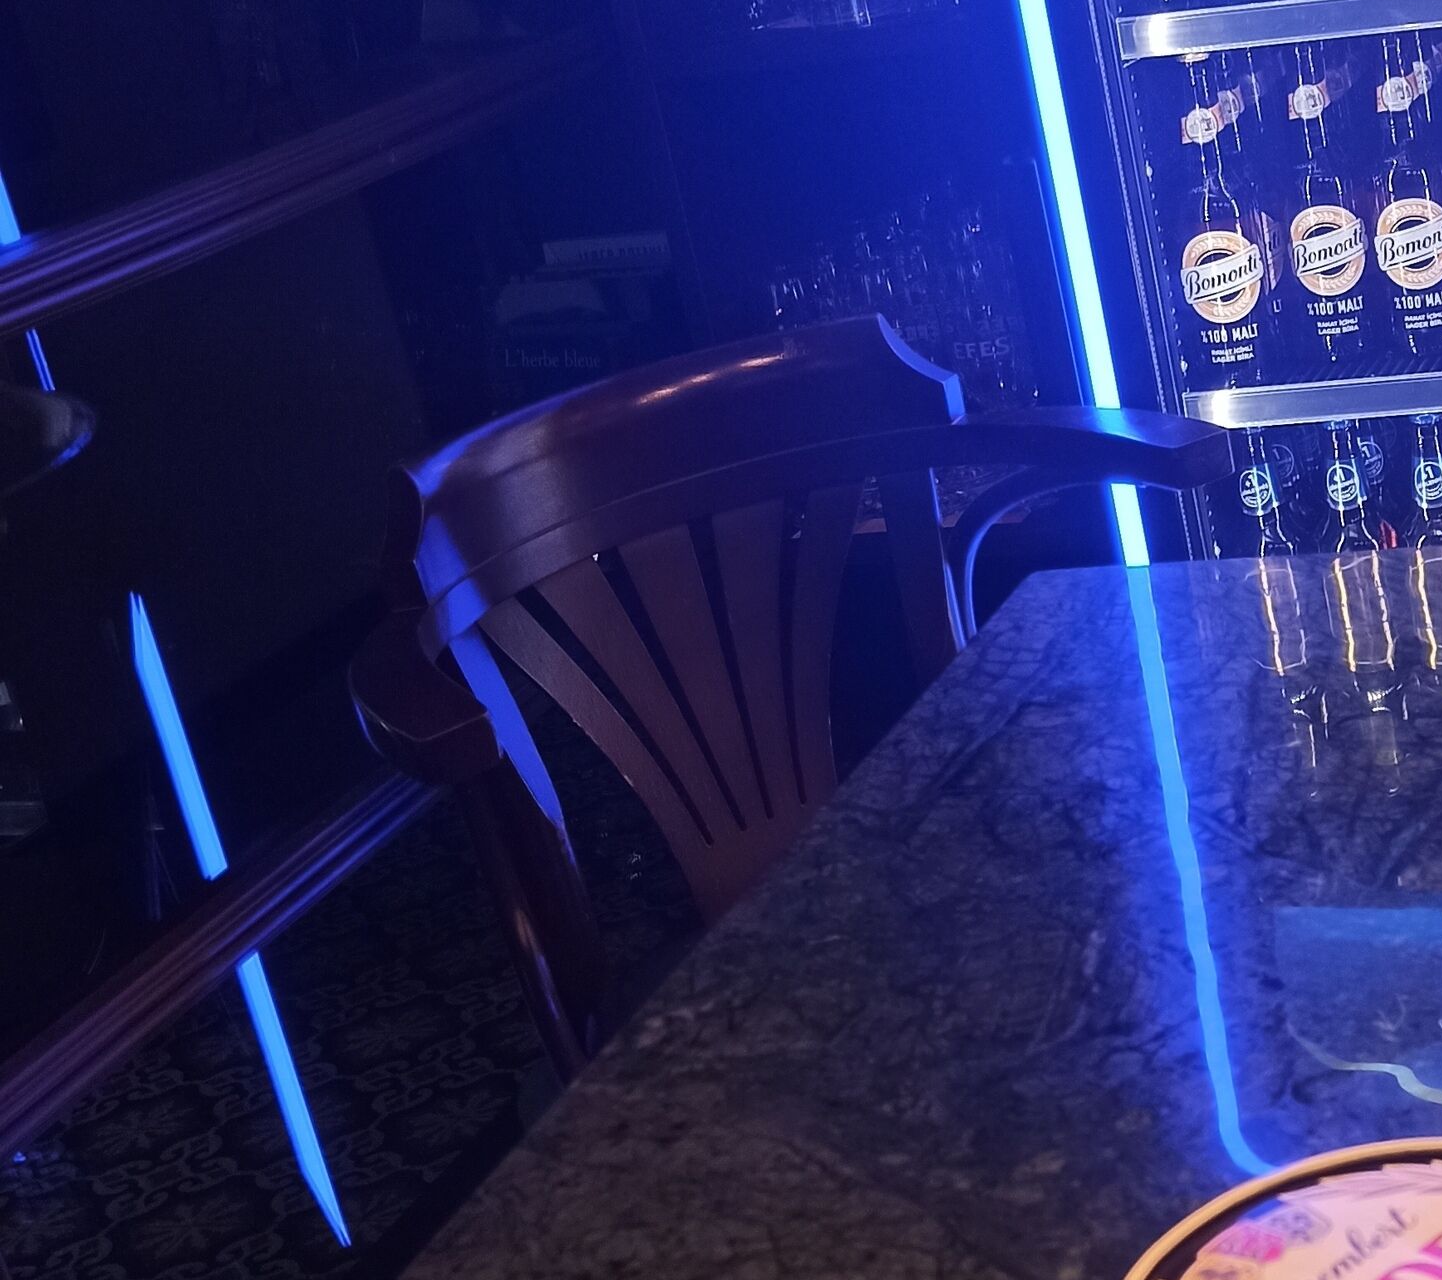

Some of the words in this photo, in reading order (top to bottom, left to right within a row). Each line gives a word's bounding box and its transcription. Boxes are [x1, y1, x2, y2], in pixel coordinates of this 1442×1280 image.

[1293, 227, 1364, 272] Bomonti
[1185, 254, 1260, 301] Bomonti
[1307, 301, 1334, 317] %100
[1337, 294, 1364, 315] MALT
[1394, 294, 1421, 311] %100
[1231, 323, 1260, 342] MALT
[503, 348, 560, 368] L'herbe
[564, 348, 601, 369] bleue
[953, 338, 1010, 361] EFES
